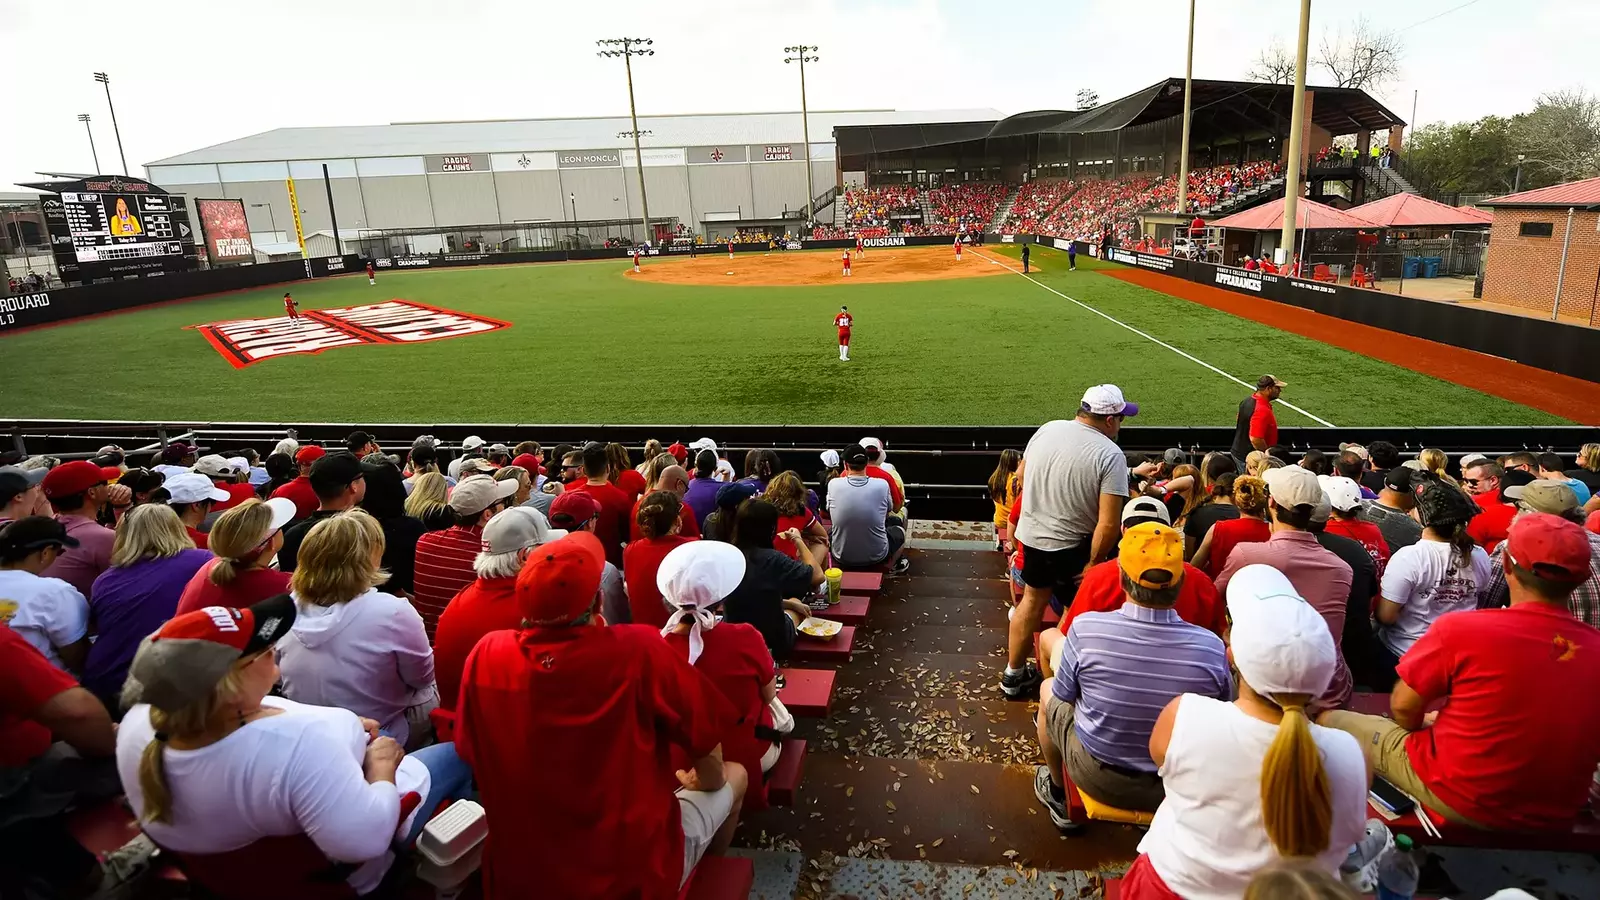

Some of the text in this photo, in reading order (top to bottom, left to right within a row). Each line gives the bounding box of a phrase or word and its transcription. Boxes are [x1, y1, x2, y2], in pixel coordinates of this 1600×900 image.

[444, 156, 468, 164] RAGIN
[583, 155, 618, 163] MONCLA
[216, 244, 252, 257] NATION
[1215, 272, 1262, 292] APPEARANCES
